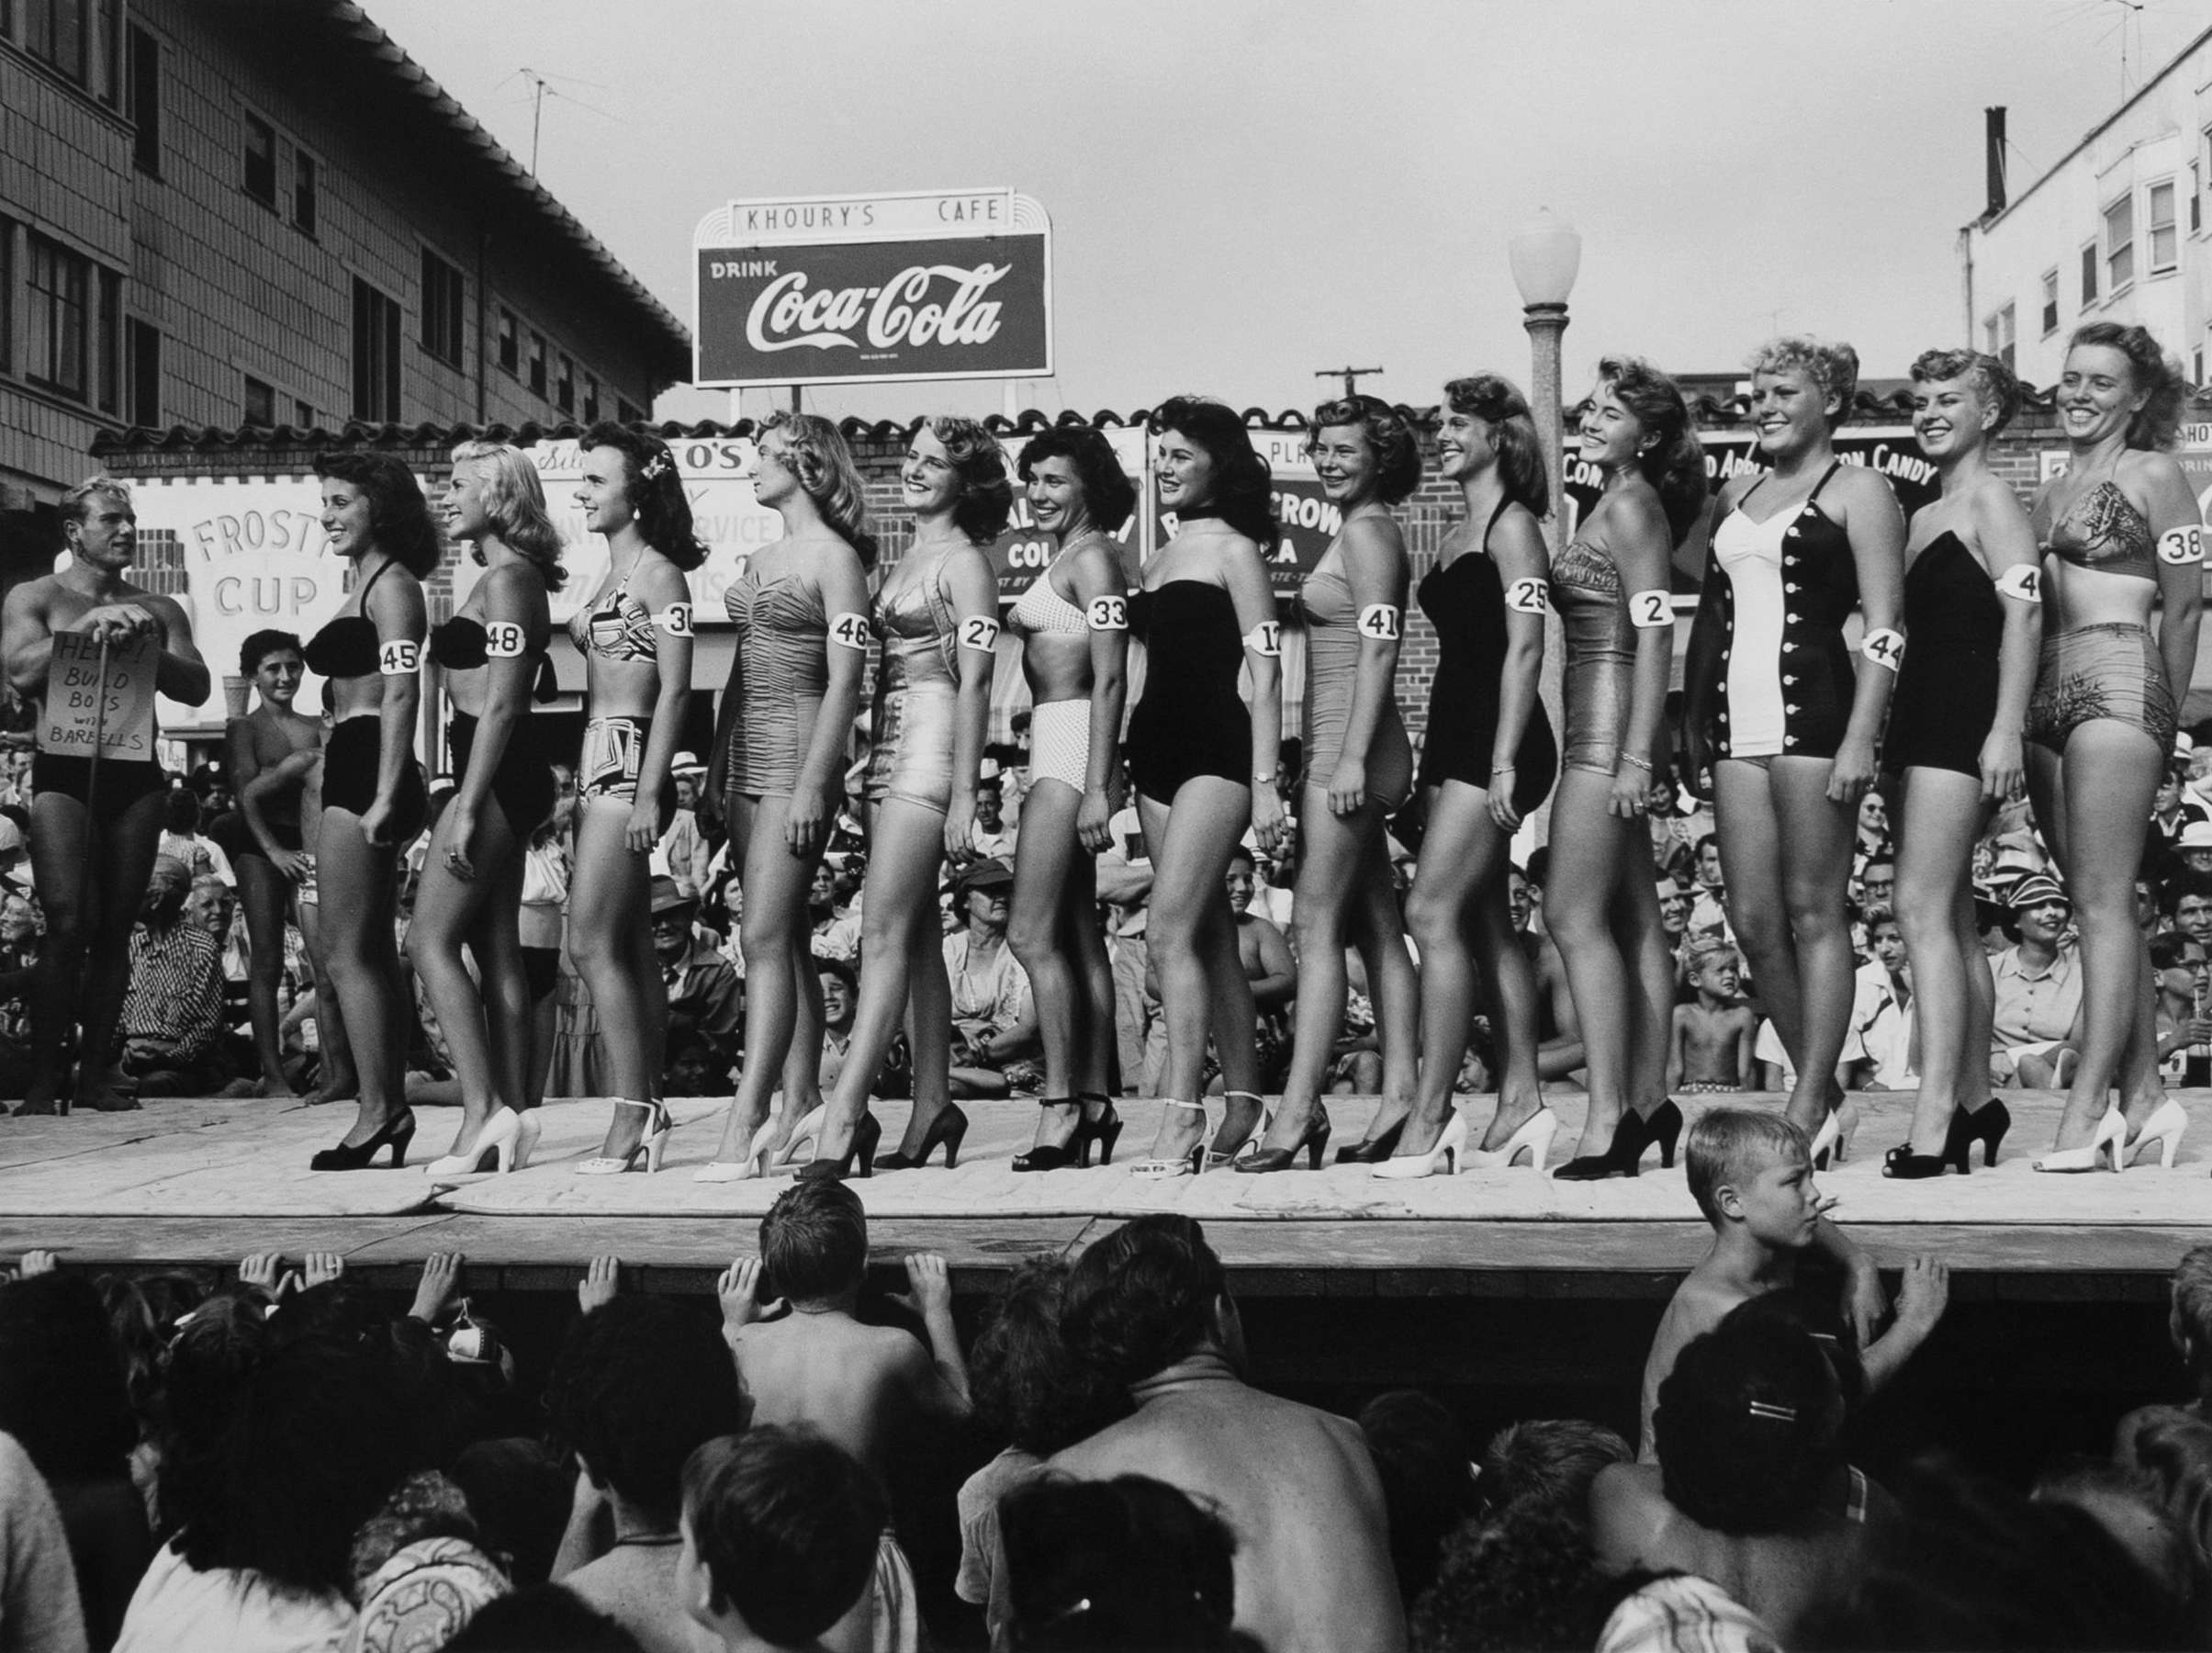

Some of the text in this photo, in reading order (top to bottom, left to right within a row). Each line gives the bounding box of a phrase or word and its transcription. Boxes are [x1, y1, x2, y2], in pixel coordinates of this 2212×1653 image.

[748, 198, 998, 231] KHOURY'S CAFE
[711, 261, 778, 278] DRINK
[746, 263, 1012, 352] Coca-Cola
[1873, 444, 1938, 486] CANDY
[193, 510, 330, 562] FROST
[2166, 529, 2202, 559] 38
[215, 577, 317, 616] CUP
[1518, 582, 1548, 610] 25
[2019, 571, 2037, 597] 4
[1095, 600, 1127, 625] 33
[1645, 596, 1663, 622] 2
[967, 620, 998, 648] 27
[1366, 610, 1396, 636] 41
[488, 626, 518, 651] 48
[383, 644, 416, 670] 45
[69, 691, 119, 711] BOS
